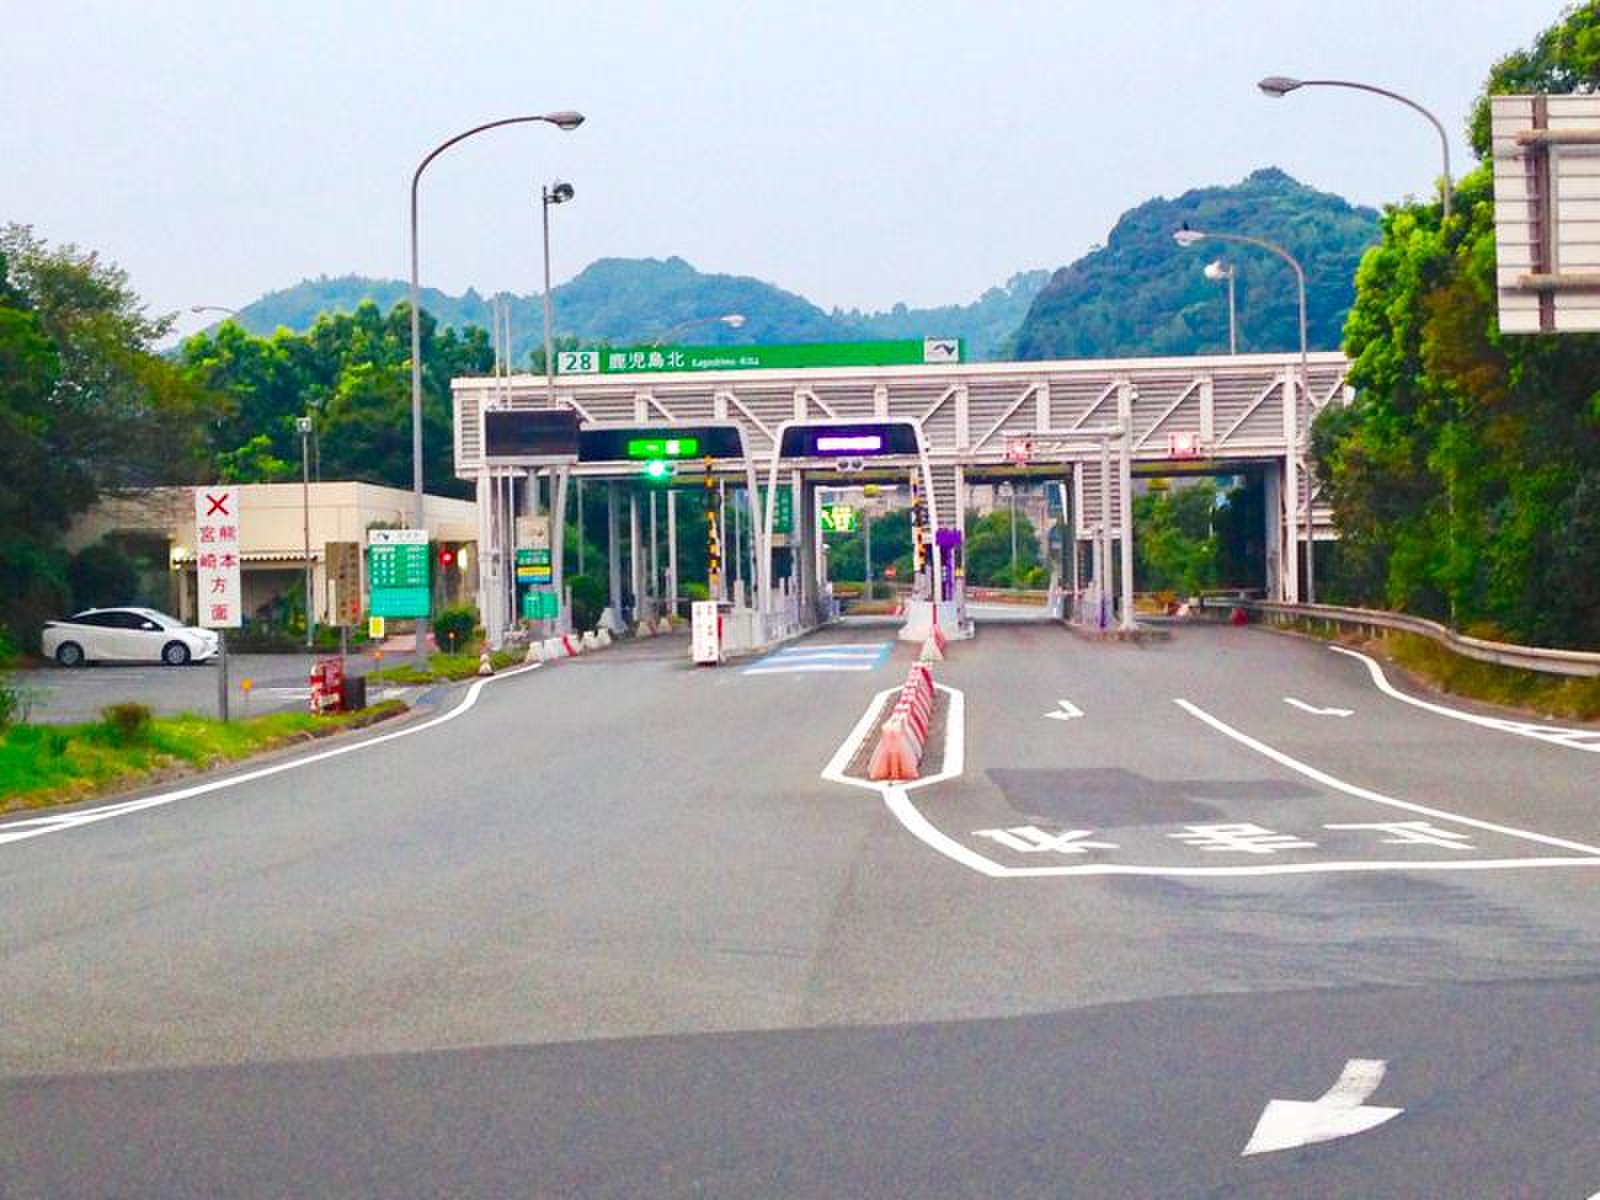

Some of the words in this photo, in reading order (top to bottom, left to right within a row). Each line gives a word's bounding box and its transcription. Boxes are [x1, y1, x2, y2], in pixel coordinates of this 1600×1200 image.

[565, 353, 592, 371] 28
[608, 351, 685, 370] 鹿児島北
[199, 525, 217, 569] 宮崎
[219, 525, 237, 568] 熊本
[209, 575, 231, 621] 方面
